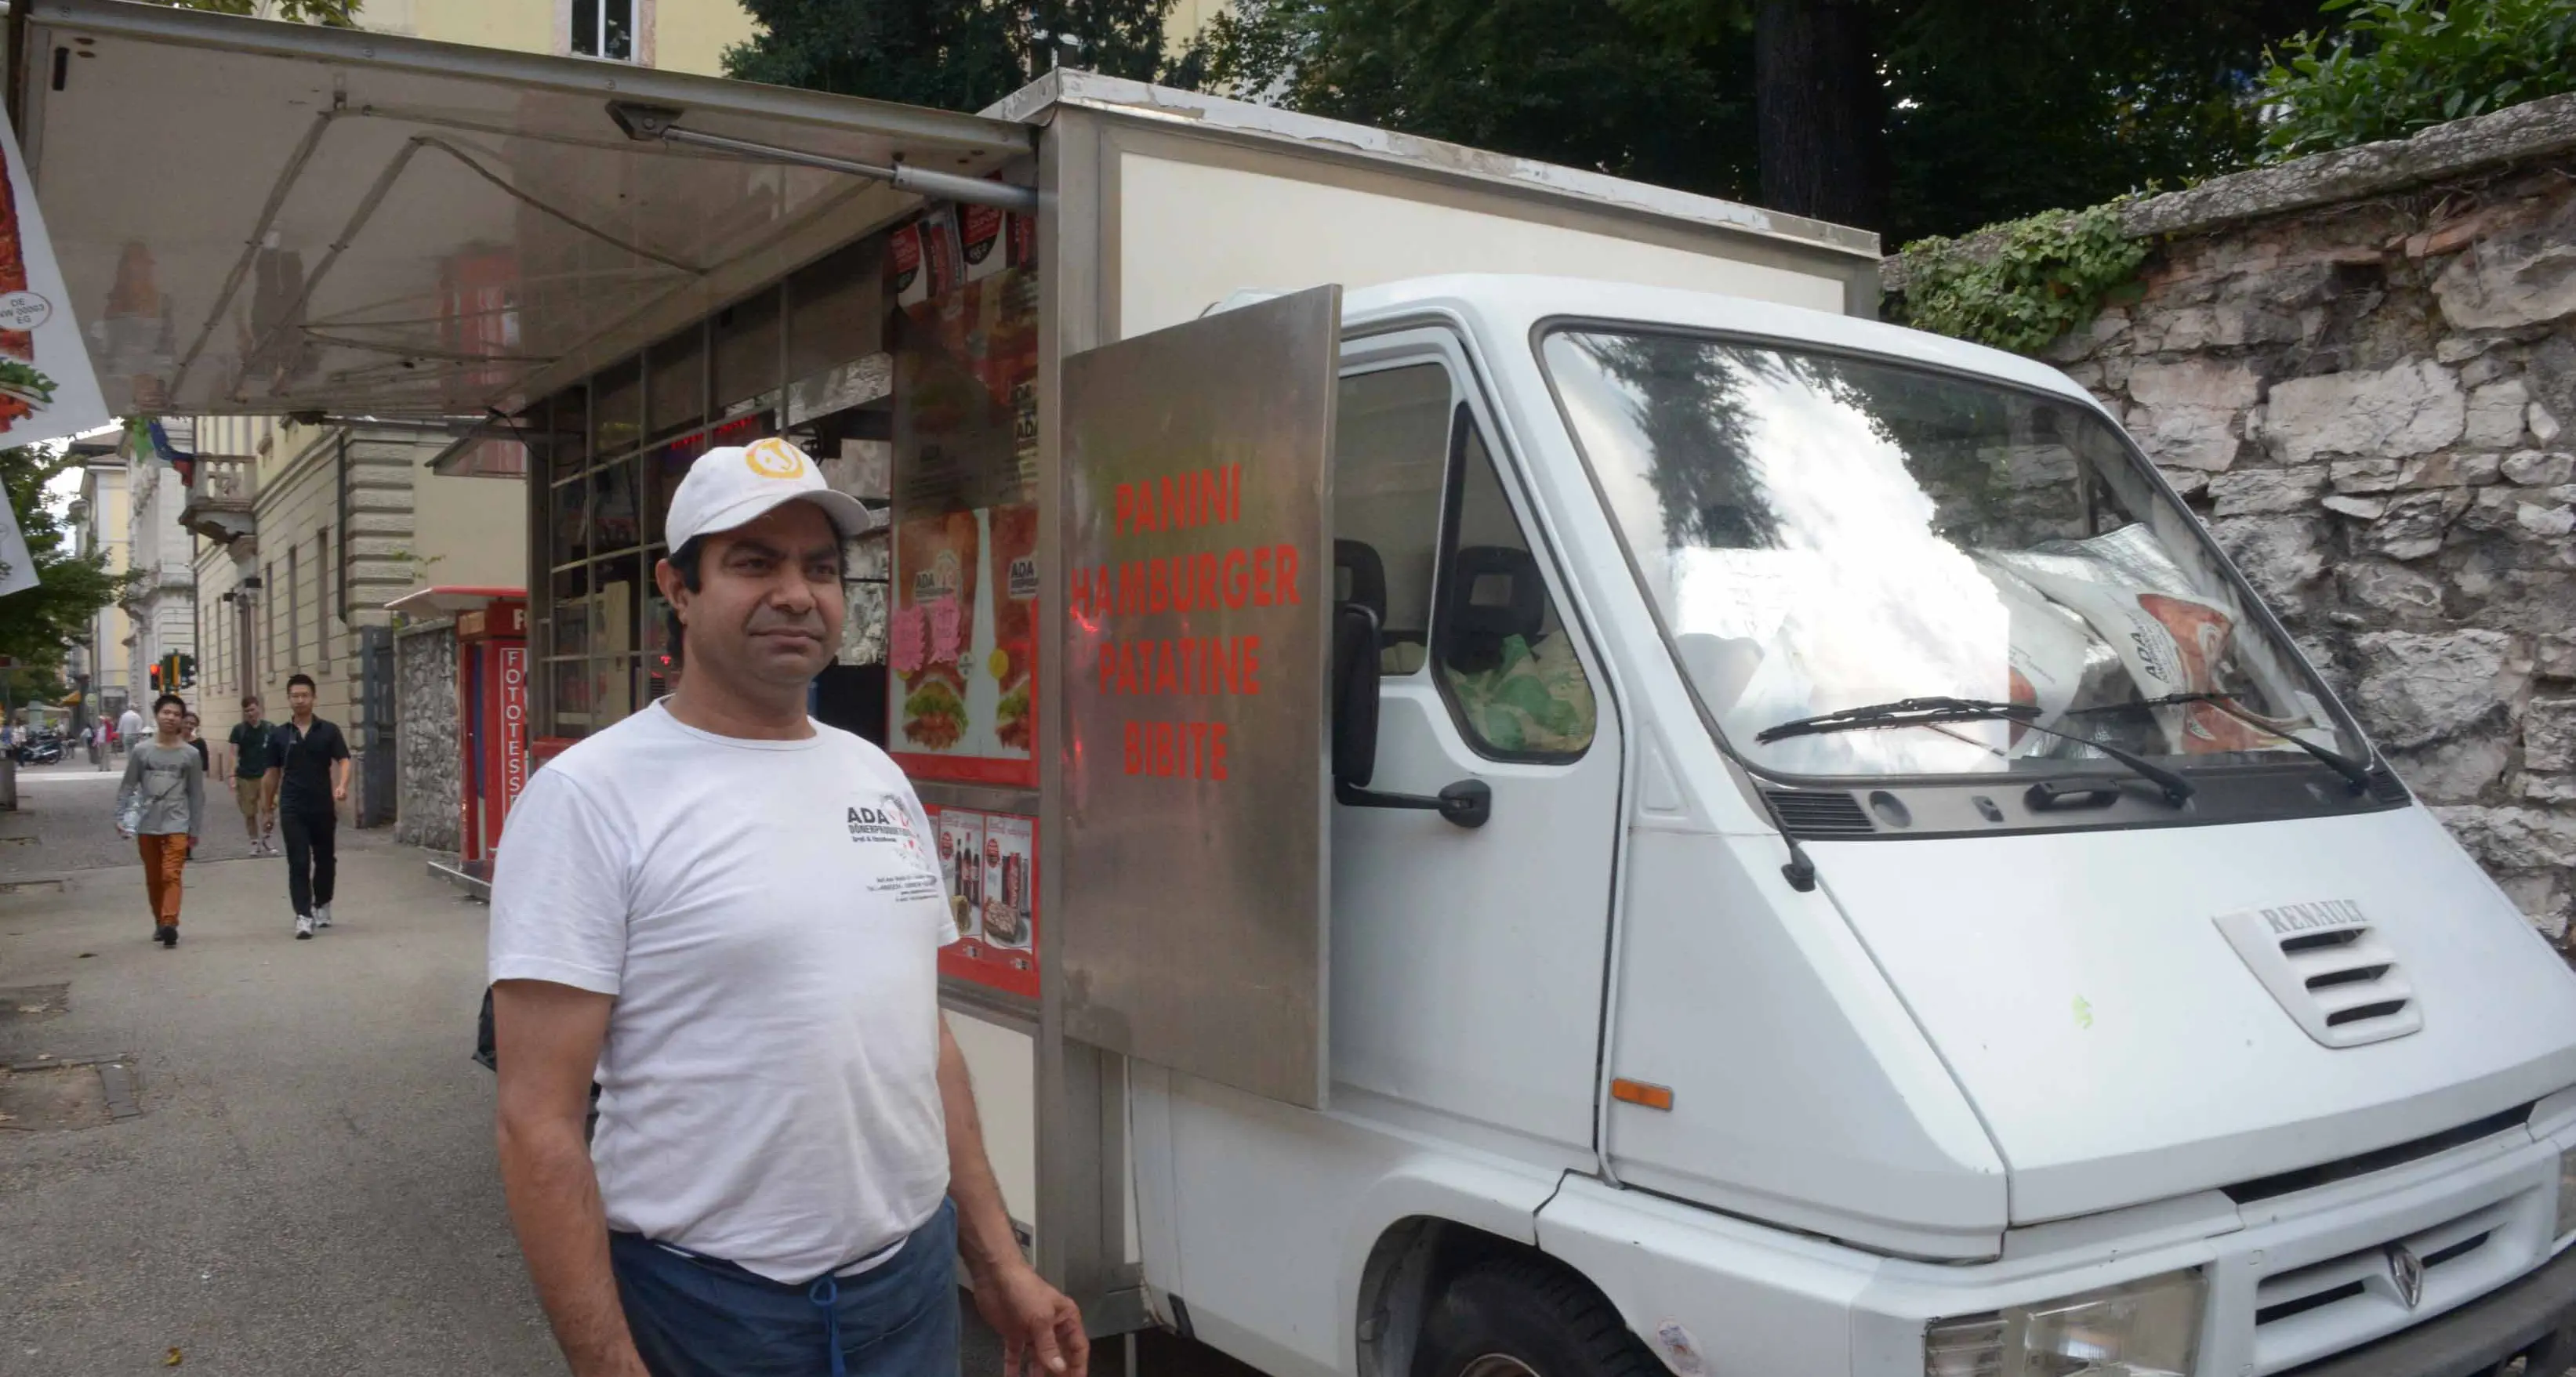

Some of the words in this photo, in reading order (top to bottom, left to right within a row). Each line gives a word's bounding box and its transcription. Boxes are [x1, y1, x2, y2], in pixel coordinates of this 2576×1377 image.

[1115, 462, 1242, 538] PANINI
[916, 573, 935, 589] ADA
[1010, 560, 1035, 578] ADA
[1071, 544, 1302, 618] HAMBURGER
[1100, 635, 1261, 695] PATATINE
[2130, 632, 2162, 680] ADA
[1123, 719, 1229, 781] BIBITE
[847, 806, 891, 825] ADA
[2259, 899, 2369, 933] RENAULT
